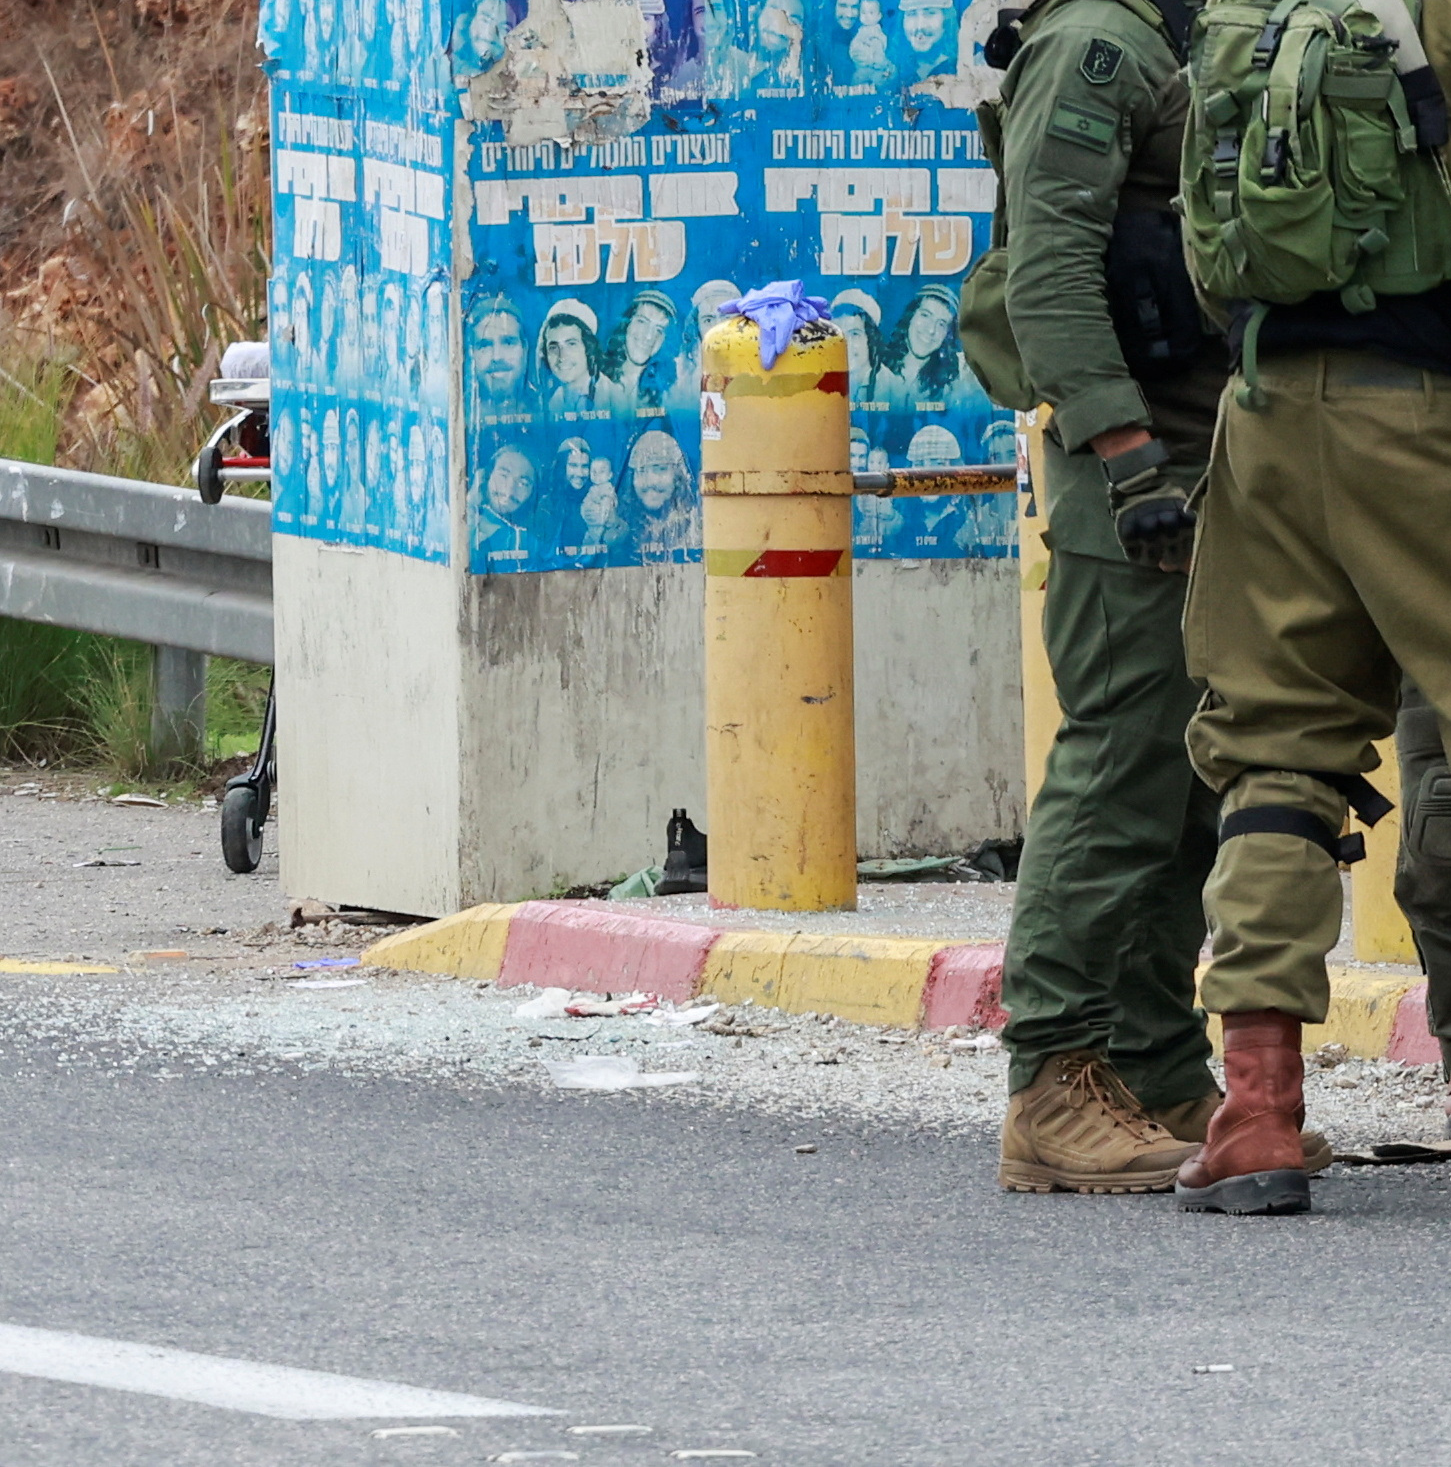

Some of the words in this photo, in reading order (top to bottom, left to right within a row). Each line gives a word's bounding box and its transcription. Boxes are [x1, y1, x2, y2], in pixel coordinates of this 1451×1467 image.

[651, 133, 731, 167] העצורים
[773, 130, 845, 161] היהודים
[851, 128, 934, 161] המנהליים
